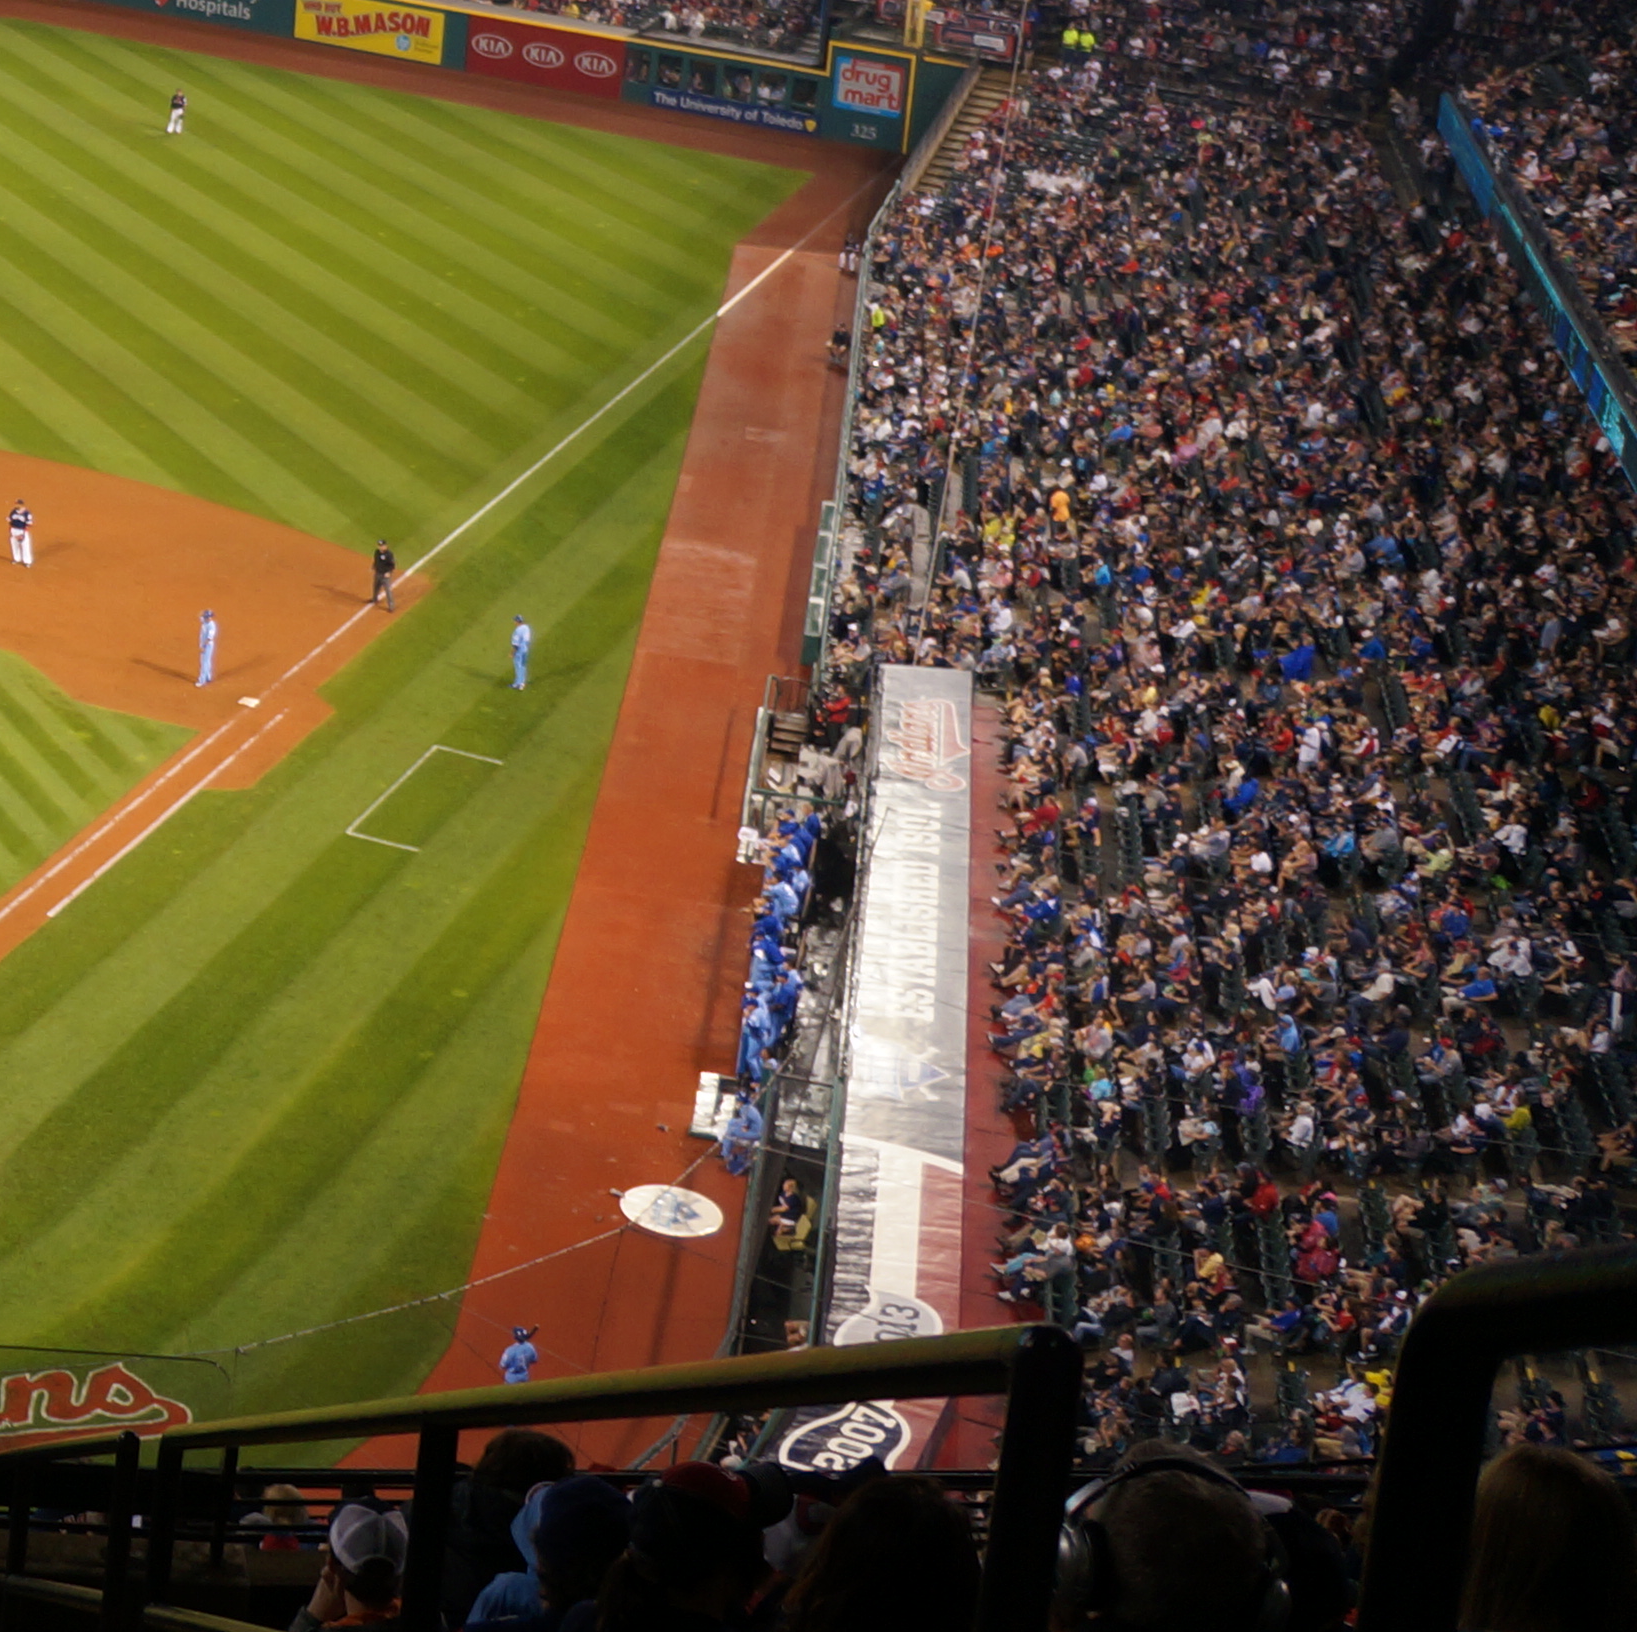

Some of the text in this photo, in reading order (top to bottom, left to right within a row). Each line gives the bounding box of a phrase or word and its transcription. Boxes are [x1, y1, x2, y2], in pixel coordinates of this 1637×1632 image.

[478, 38, 610, 74] KIA KIA KIA
[841, 70, 893, 92] drug
[653, 91, 805, 131] The University of Toledo
[843, 88, 902, 112] mart
[851, 123, 877, 139] 325
[882, 698, 970, 792] Indians
